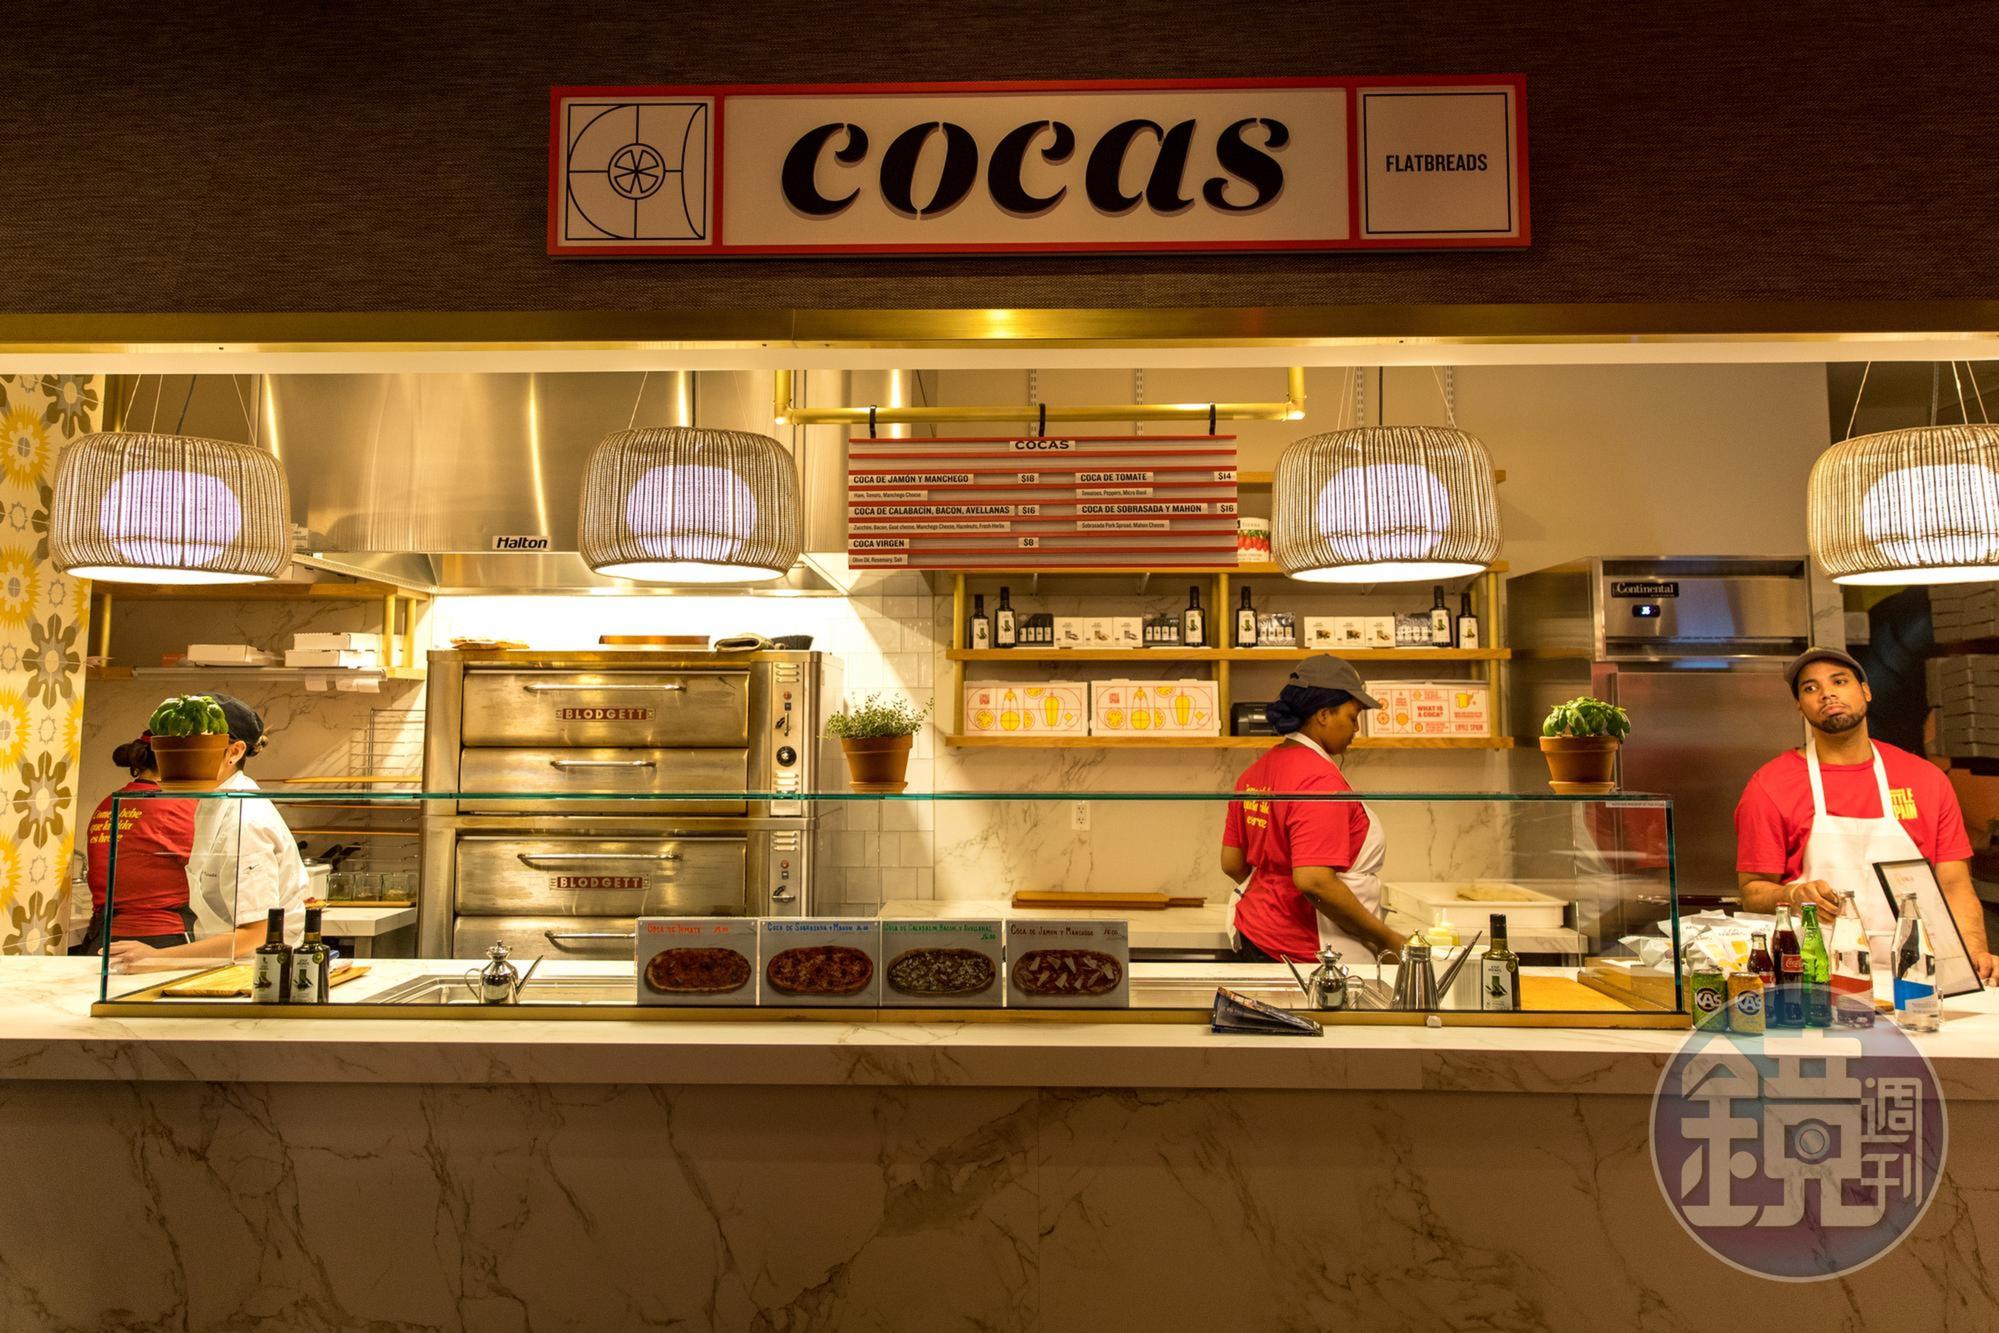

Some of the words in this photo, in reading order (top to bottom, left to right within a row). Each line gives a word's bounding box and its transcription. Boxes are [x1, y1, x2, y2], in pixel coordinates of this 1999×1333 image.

[781, 117, 1291, 218] cocas
[1385, 153, 1488, 172] FLATBREADS
[1014, 440, 1070, 450] COCAS
[853, 475, 875, 484] COCA
[876, 475, 887, 484] DE
[887, 474, 916, 483] JAMÓN
[918, 475, 925, 483] Y
[925, 474, 969, 483] MANCHEGO
[1080, 473, 1102, 482] COCA
[1103, 473, 1114, 481] DE
[1115, 472, 1148, 481] TOMATE
[1218, 471, 1232, 481] $14
[854, 507, 875, 516] COCA
[876, 507, 888, 515] DE
[965, 505, 1010, 514] AVELLANAS
[1022, 506, 1036, 515] $16
[1081, 505, 1104, 514] COCA
[1104, 505, 1116, 513] DE
[1116, 505, 1164, 513] SOBRASADA
[1165, 505, 1171, 513] Y
[1220, 504, 1234, 513] $16
[496, 536, 548, 549] Halton
[853, 539, 875, 548] COCA
[875, 539, 905, 548] VIRGEN
[1616, 582, 1674, 594] Continental
[565, 708, 644, 720] BLODGETT
[560, 876, 643, 889] BLODGETT
[1694, 992, 1721, 1009] KAS
[1737, 995, 1762, 1011] KAS
